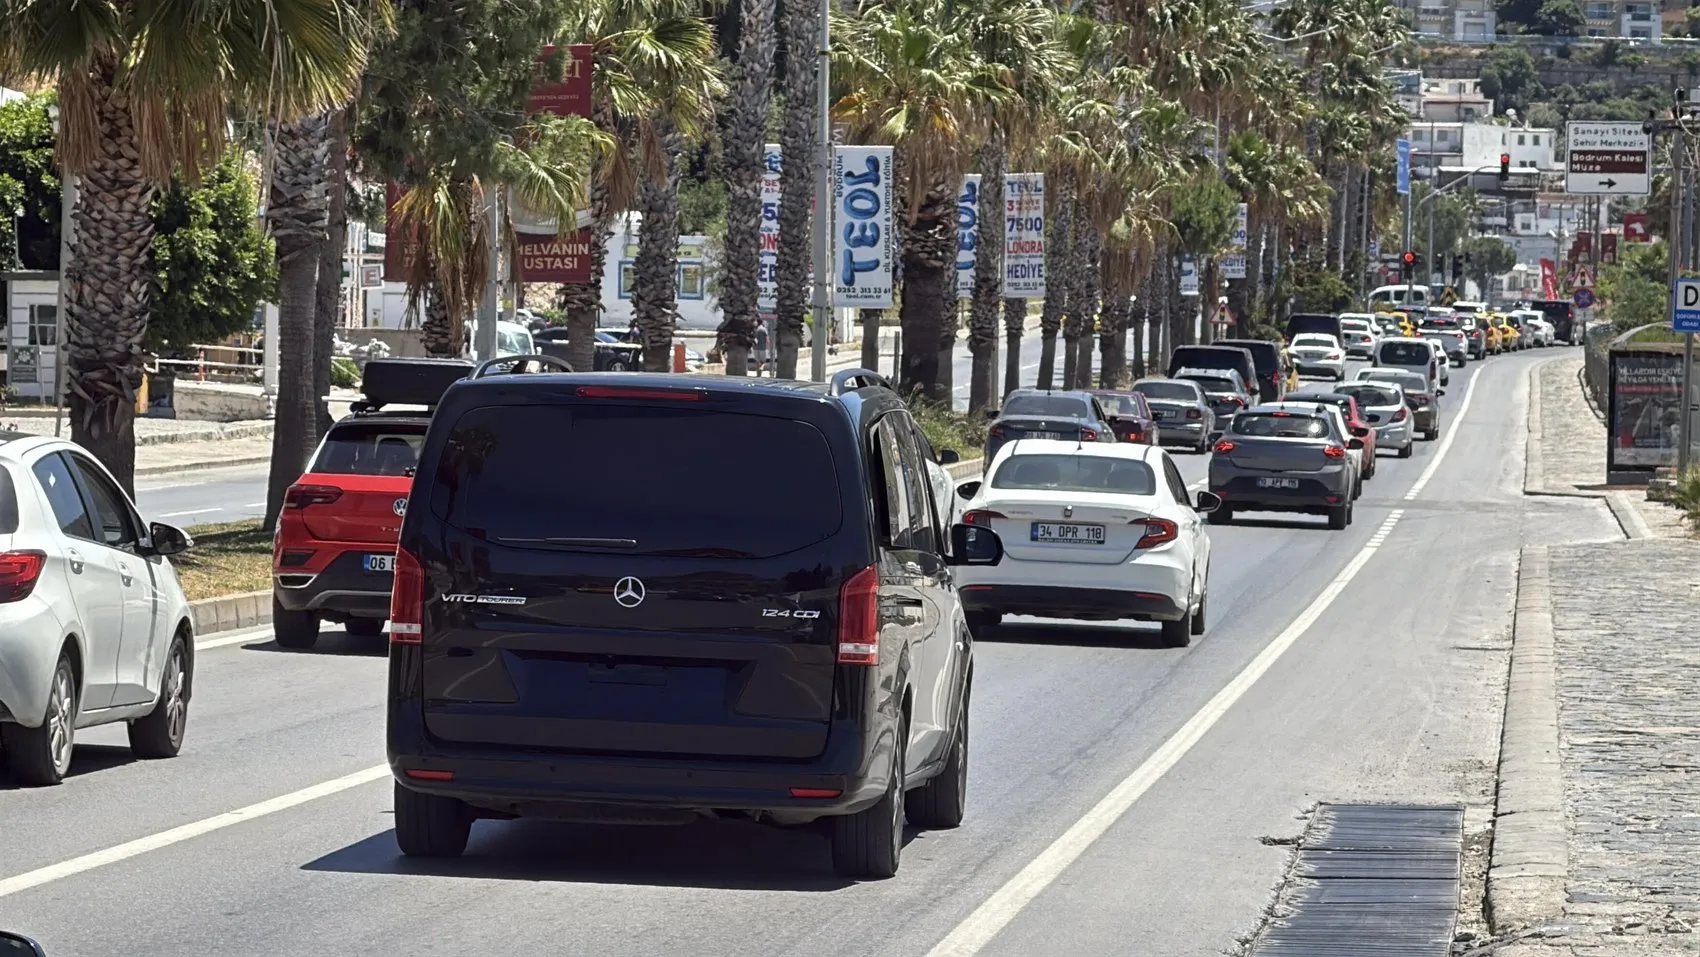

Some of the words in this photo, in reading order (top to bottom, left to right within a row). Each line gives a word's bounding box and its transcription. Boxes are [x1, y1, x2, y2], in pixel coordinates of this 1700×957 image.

[1572, 153, 1612, 162] Bodrum
[1614, 154, 1643, 162] Kalesi
[835, 155, 843, 198] BODRUM
[1007, 200, 1014, 211] 3
[842, 155, 881, 287] TEOL
[1007, 217, 1042, 232] 7500
[1007, 240, 1043, 254] LONDRA
[524, 257, 578, 270] USTASI
[1007, 259, 1043, 278] HEDİYE
[1684, 285, 1699, 306] D
[1040, 525, 1052, 537] 34
[1058, 526, 1079, 538] DPR
[1086, 527, 1102, 539] 118
[370, 557, 386, 570] 06
[441, 593, 477, 602] VITO
[762, 608, 790, 617] 124
[793, 610, 820, 618] CDI
